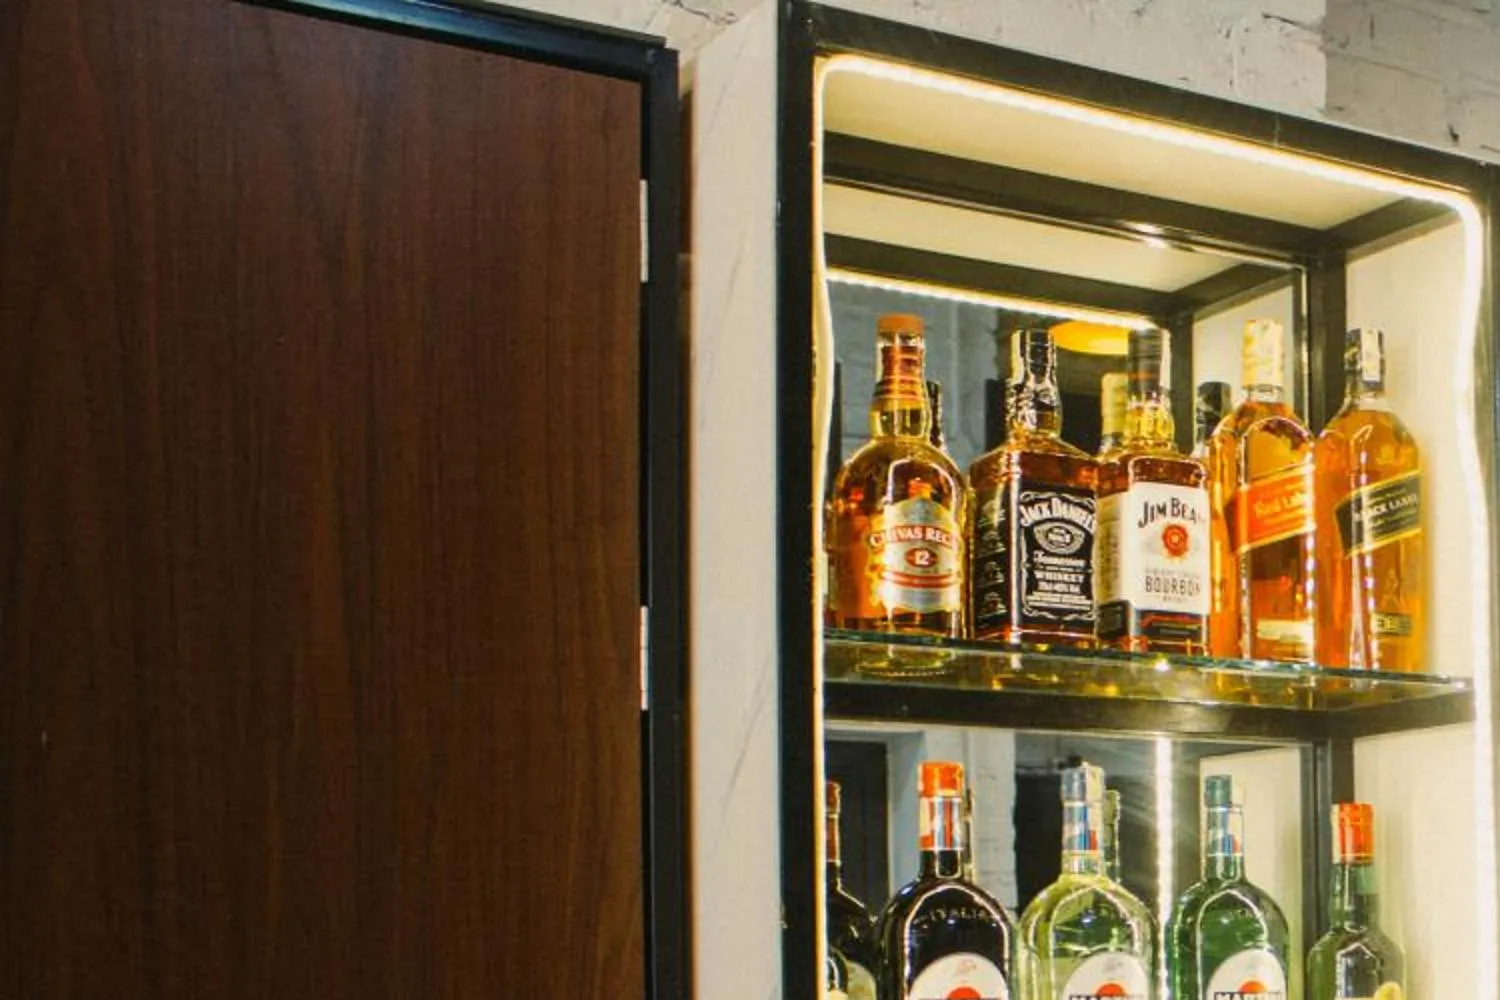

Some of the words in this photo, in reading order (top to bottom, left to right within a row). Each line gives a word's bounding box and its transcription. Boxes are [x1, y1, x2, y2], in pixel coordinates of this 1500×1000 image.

[1020, 503, 1050, 528] JACK
[1137, 501, 1167, 528] JIM
[1170, 497, 1206, 525] BEA
[1354, 502, 1388, 523] BACK
[925, 527, 959, 549] REG
[914, 551, 930, 566] 12
